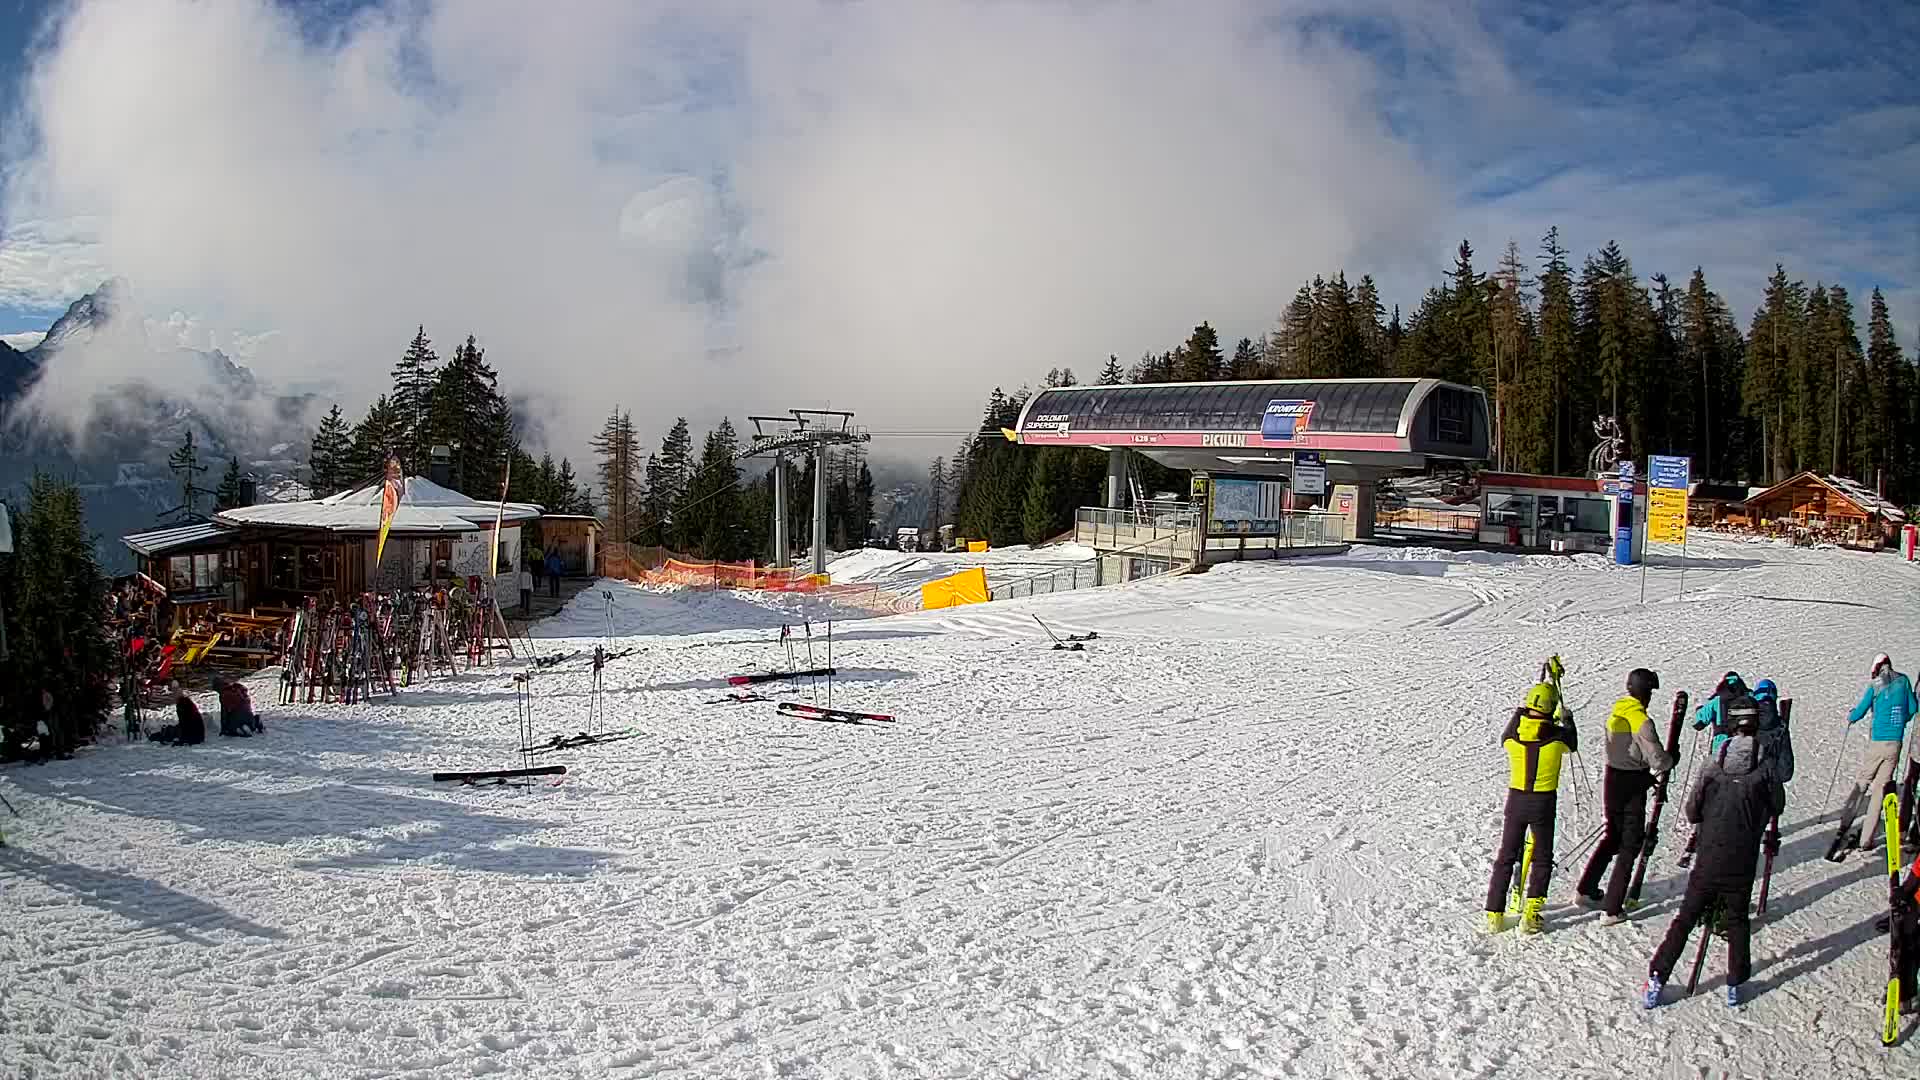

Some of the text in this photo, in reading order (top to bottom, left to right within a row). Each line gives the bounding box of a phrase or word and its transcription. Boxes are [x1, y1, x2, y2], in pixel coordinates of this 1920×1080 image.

[1266, 405, 1313, 413] KRONPLATZ
[1036, 414, 1069, 422] DOLOMITI
[1202, 434, 1246, 447] PICULIN
